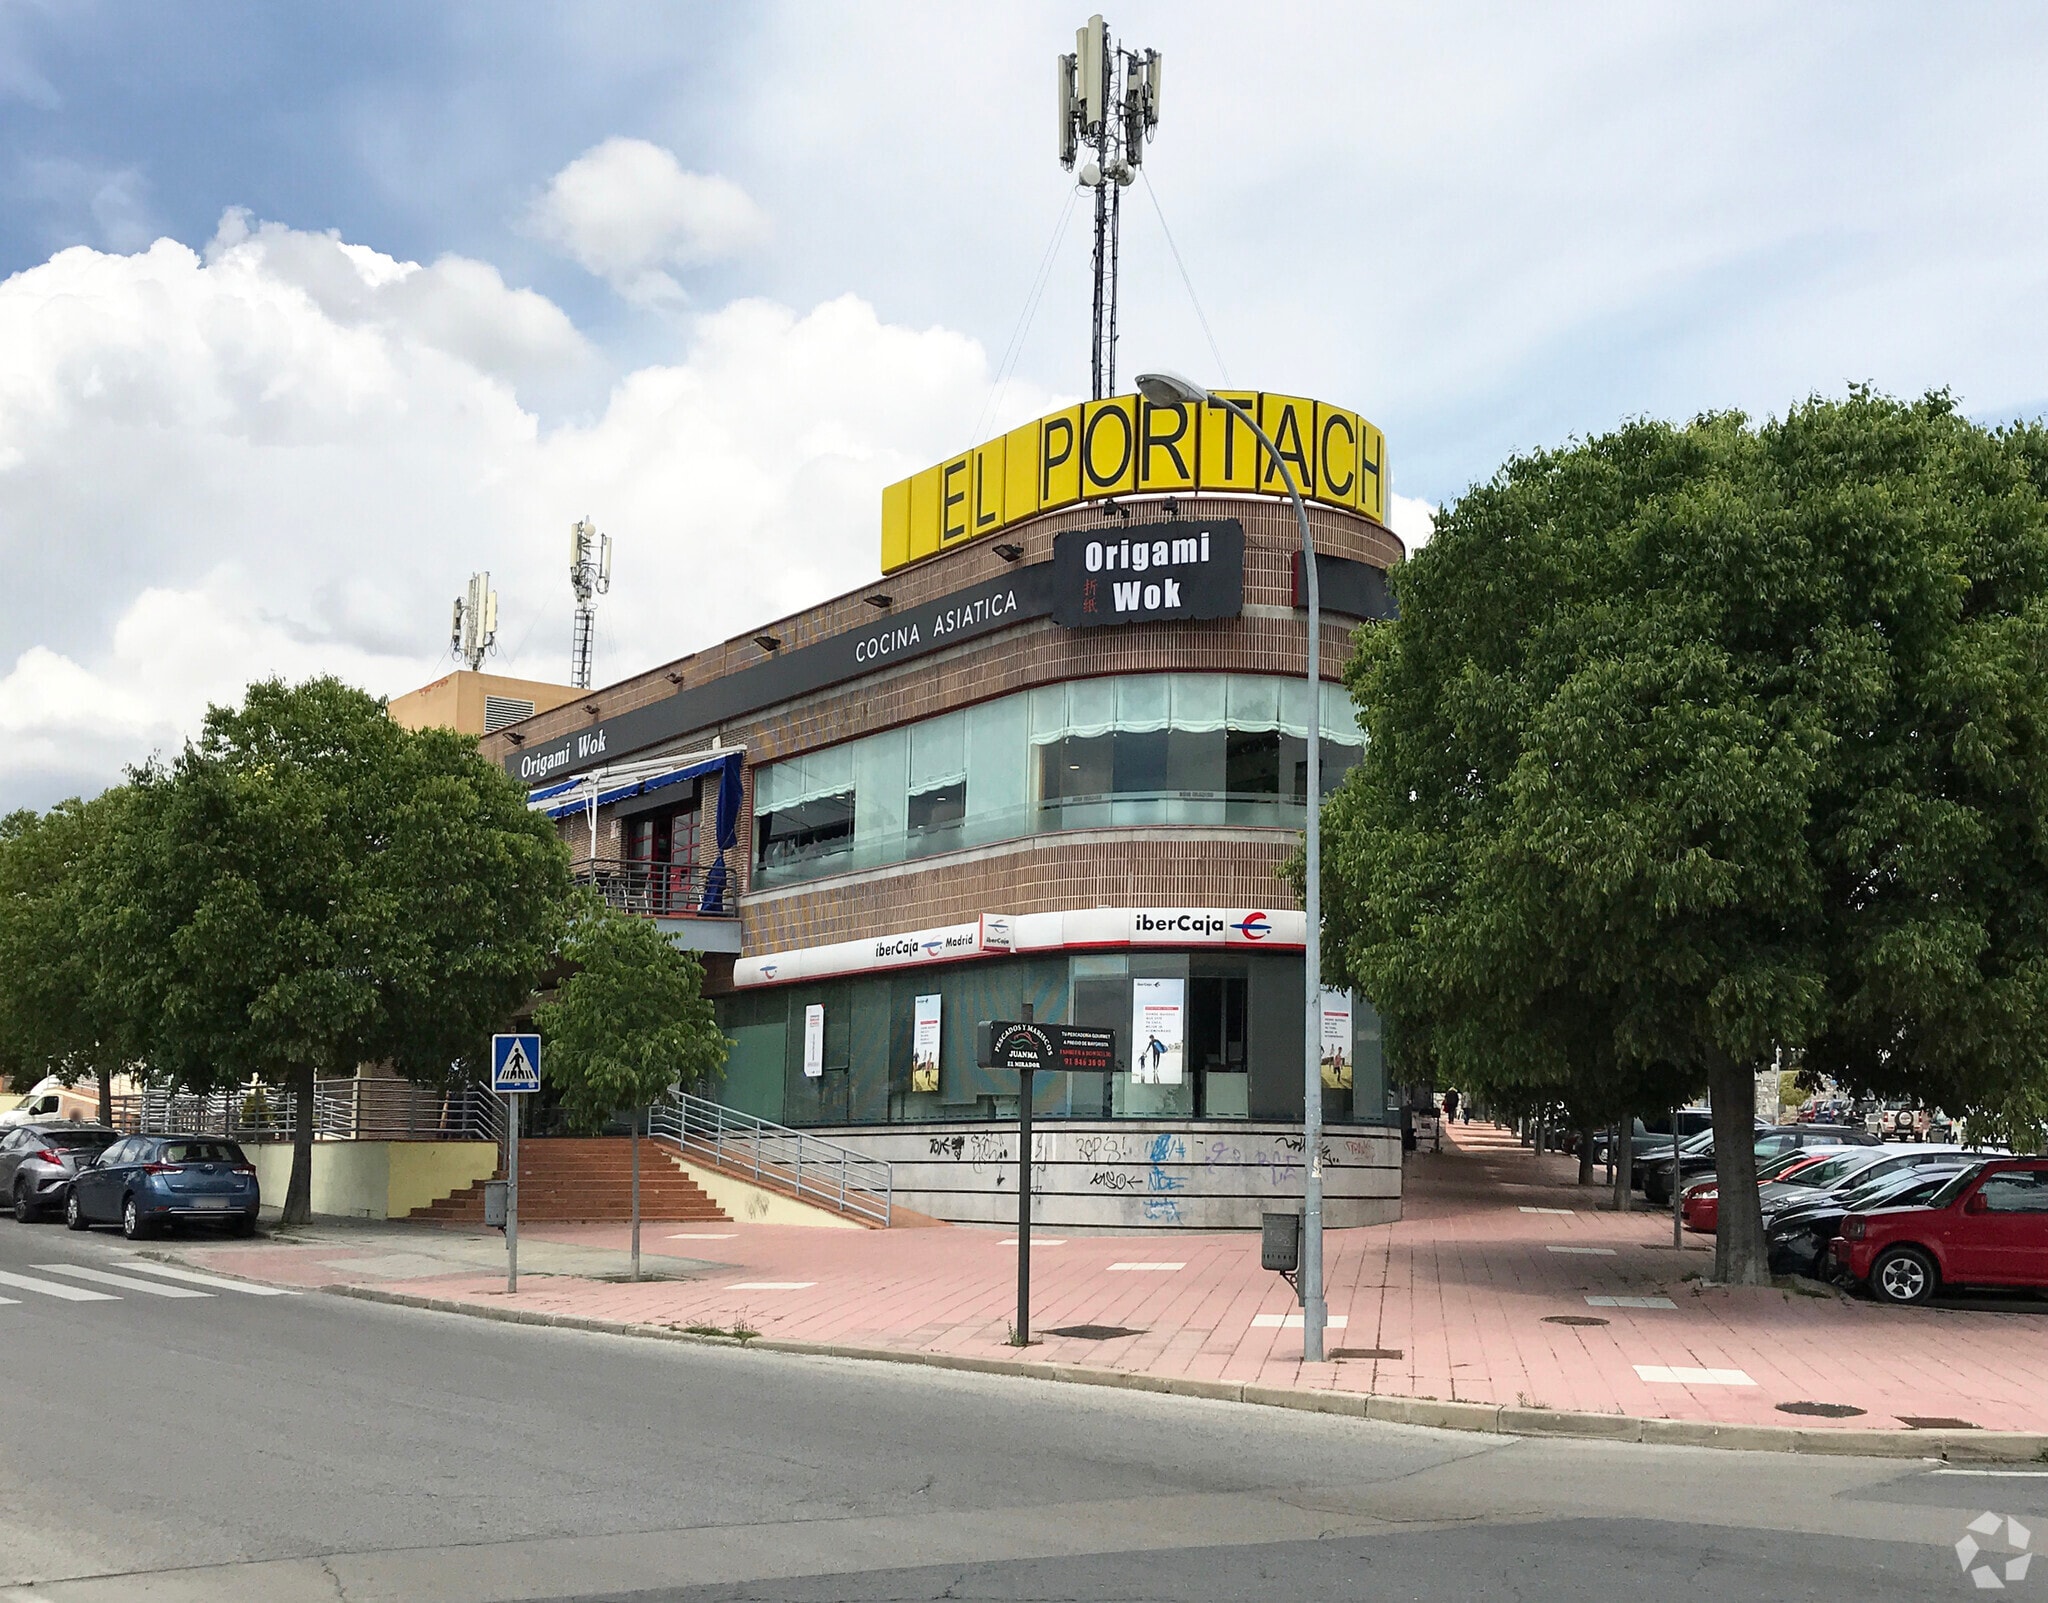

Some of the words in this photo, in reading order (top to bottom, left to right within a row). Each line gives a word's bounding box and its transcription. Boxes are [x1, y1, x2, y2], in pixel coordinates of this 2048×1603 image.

[943, 460, 997, 539] EL
[1085, 531, 1210, 572] Origami
[1112, 577, 1181, 612] Wok
[855, 623, 921, 663] COCINA
[933, 590, 1017, 637] ASIATICA
[521, 741, 570, 778] Origami
[578, 729, 607, 759] Wok
[986, 936, 1010, 945] iberCaja
[1135, 913, 1224, 936] iberCaja
[875, 938, 919, 957] iberCaja
[945, 933, 974, 948] Madrid
[994, 1023, 1021, 1053] PESCADOS
[1022, 1023, 1027, 1031] Y
[1027, 1024, 1054, 1056] MARISCOS
[1008, 1050, 1039, 1060] JUANMA
